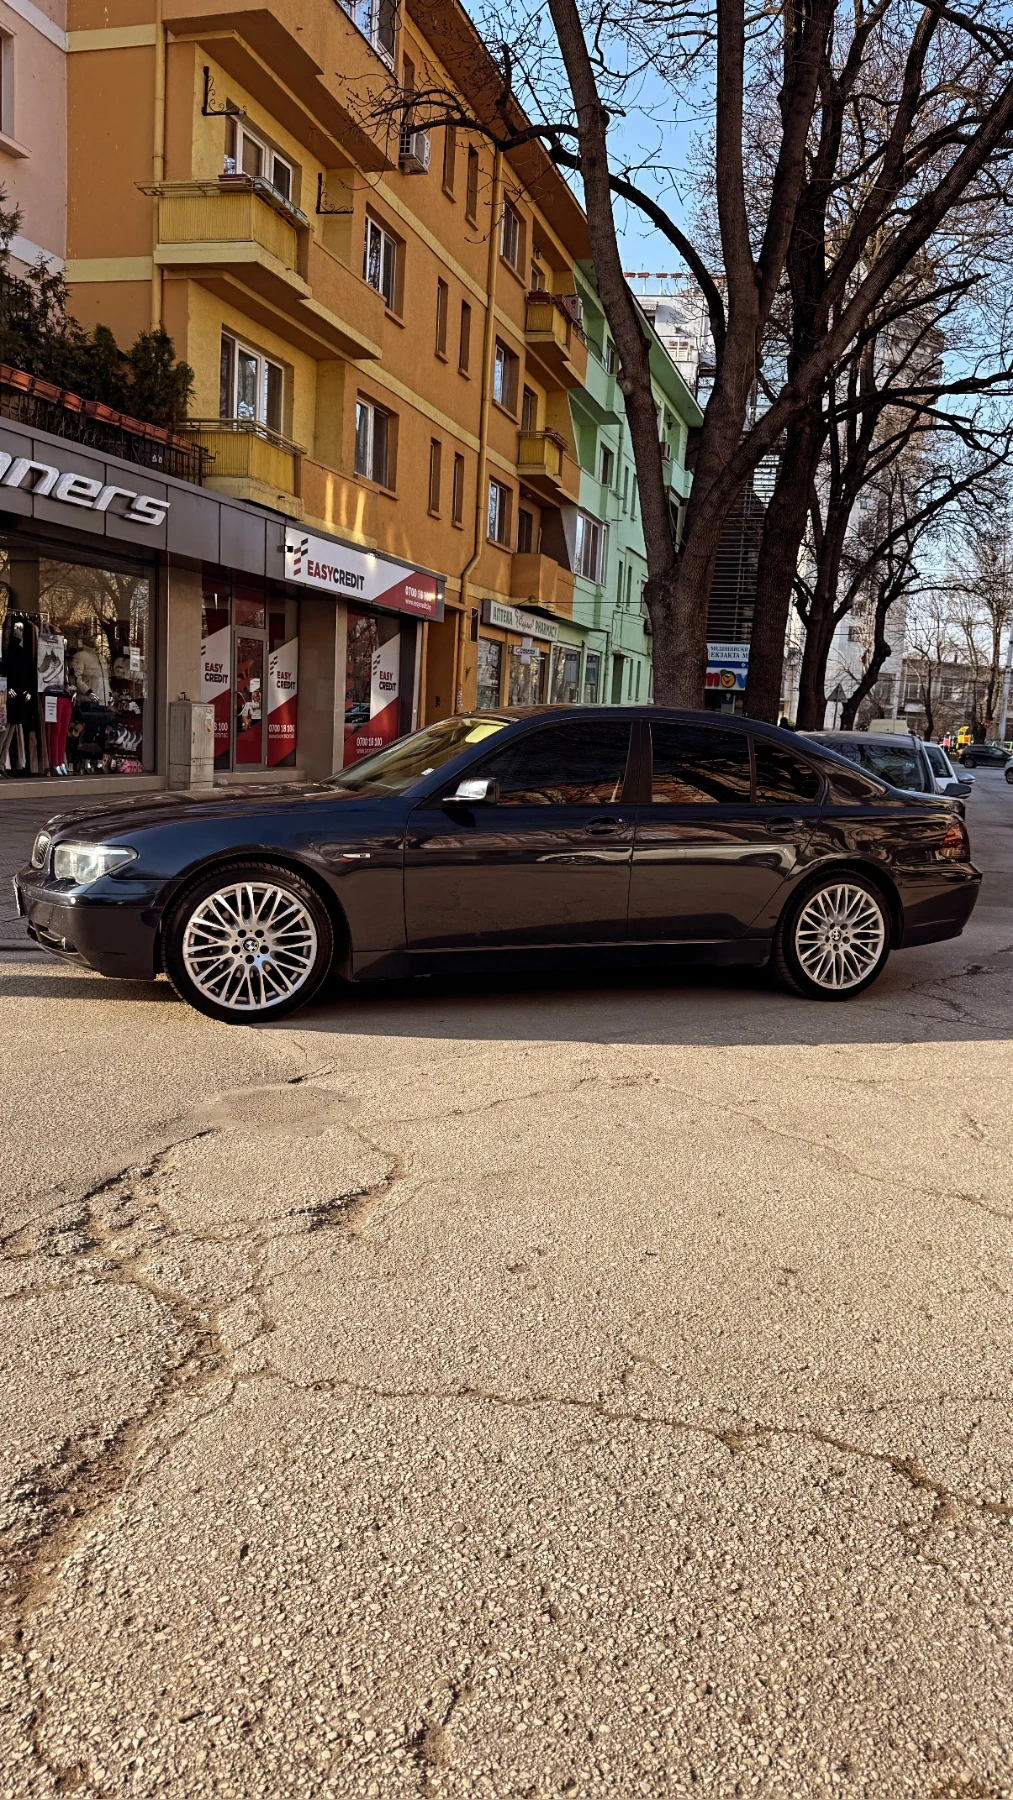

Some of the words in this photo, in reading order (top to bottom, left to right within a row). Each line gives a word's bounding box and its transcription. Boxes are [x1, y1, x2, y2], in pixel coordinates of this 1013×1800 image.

[307, 559, 365, 590] EASYCREDIT
[405, 585, 417, 598] 0700
[492, 606, 513, 625] АПТЕКА
[535, 620, 557, 639] PHARMACY
[710, 651, 740, 659] ЕКЗАКТА
[204, 662, 223, 673] EASY
[204, 672, 229, 684] CREDIT
[276, 670, 292, 681] EASY
[379, 670, 394, 681] EASY
[276, 680, 296, 690] CREDIT
[379, 681, 397, 692] CREDIT
[218, 722, 229, 732] 100
[268, 724, 280, 733] 0700
